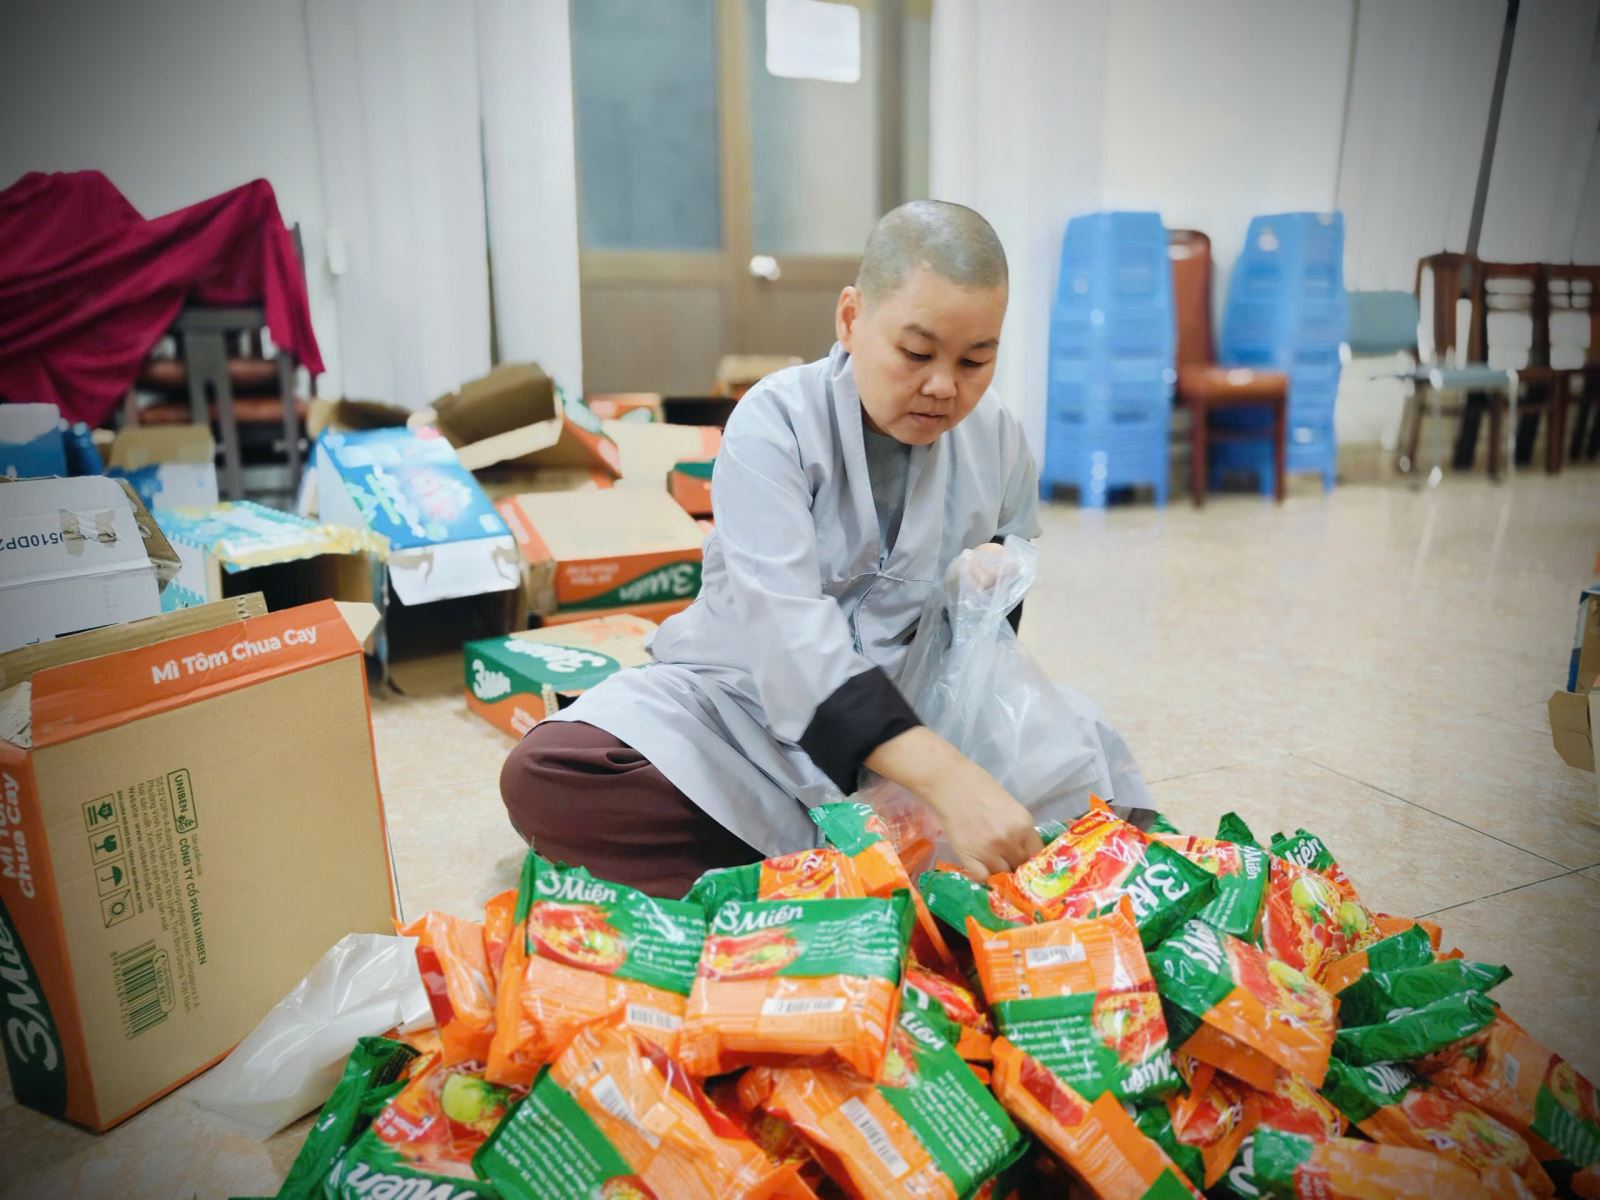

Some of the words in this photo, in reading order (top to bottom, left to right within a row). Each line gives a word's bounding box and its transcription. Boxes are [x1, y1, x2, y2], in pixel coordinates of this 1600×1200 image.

[151, 660, 180, 684] Mì
[182, 652, 228, 675] Tôm
[231, 636, 281, 660] Chua
[283, 626, 317, 646] Cay
[174, 773, 188, 813] UNIBEN
[134, 822, 154, 909] www.unibenfoods.com
[179, 836, 194, 866] CÔNG
[184, 865, 196, 881] TY
[194, 926, 209, 965] UNIBEN
